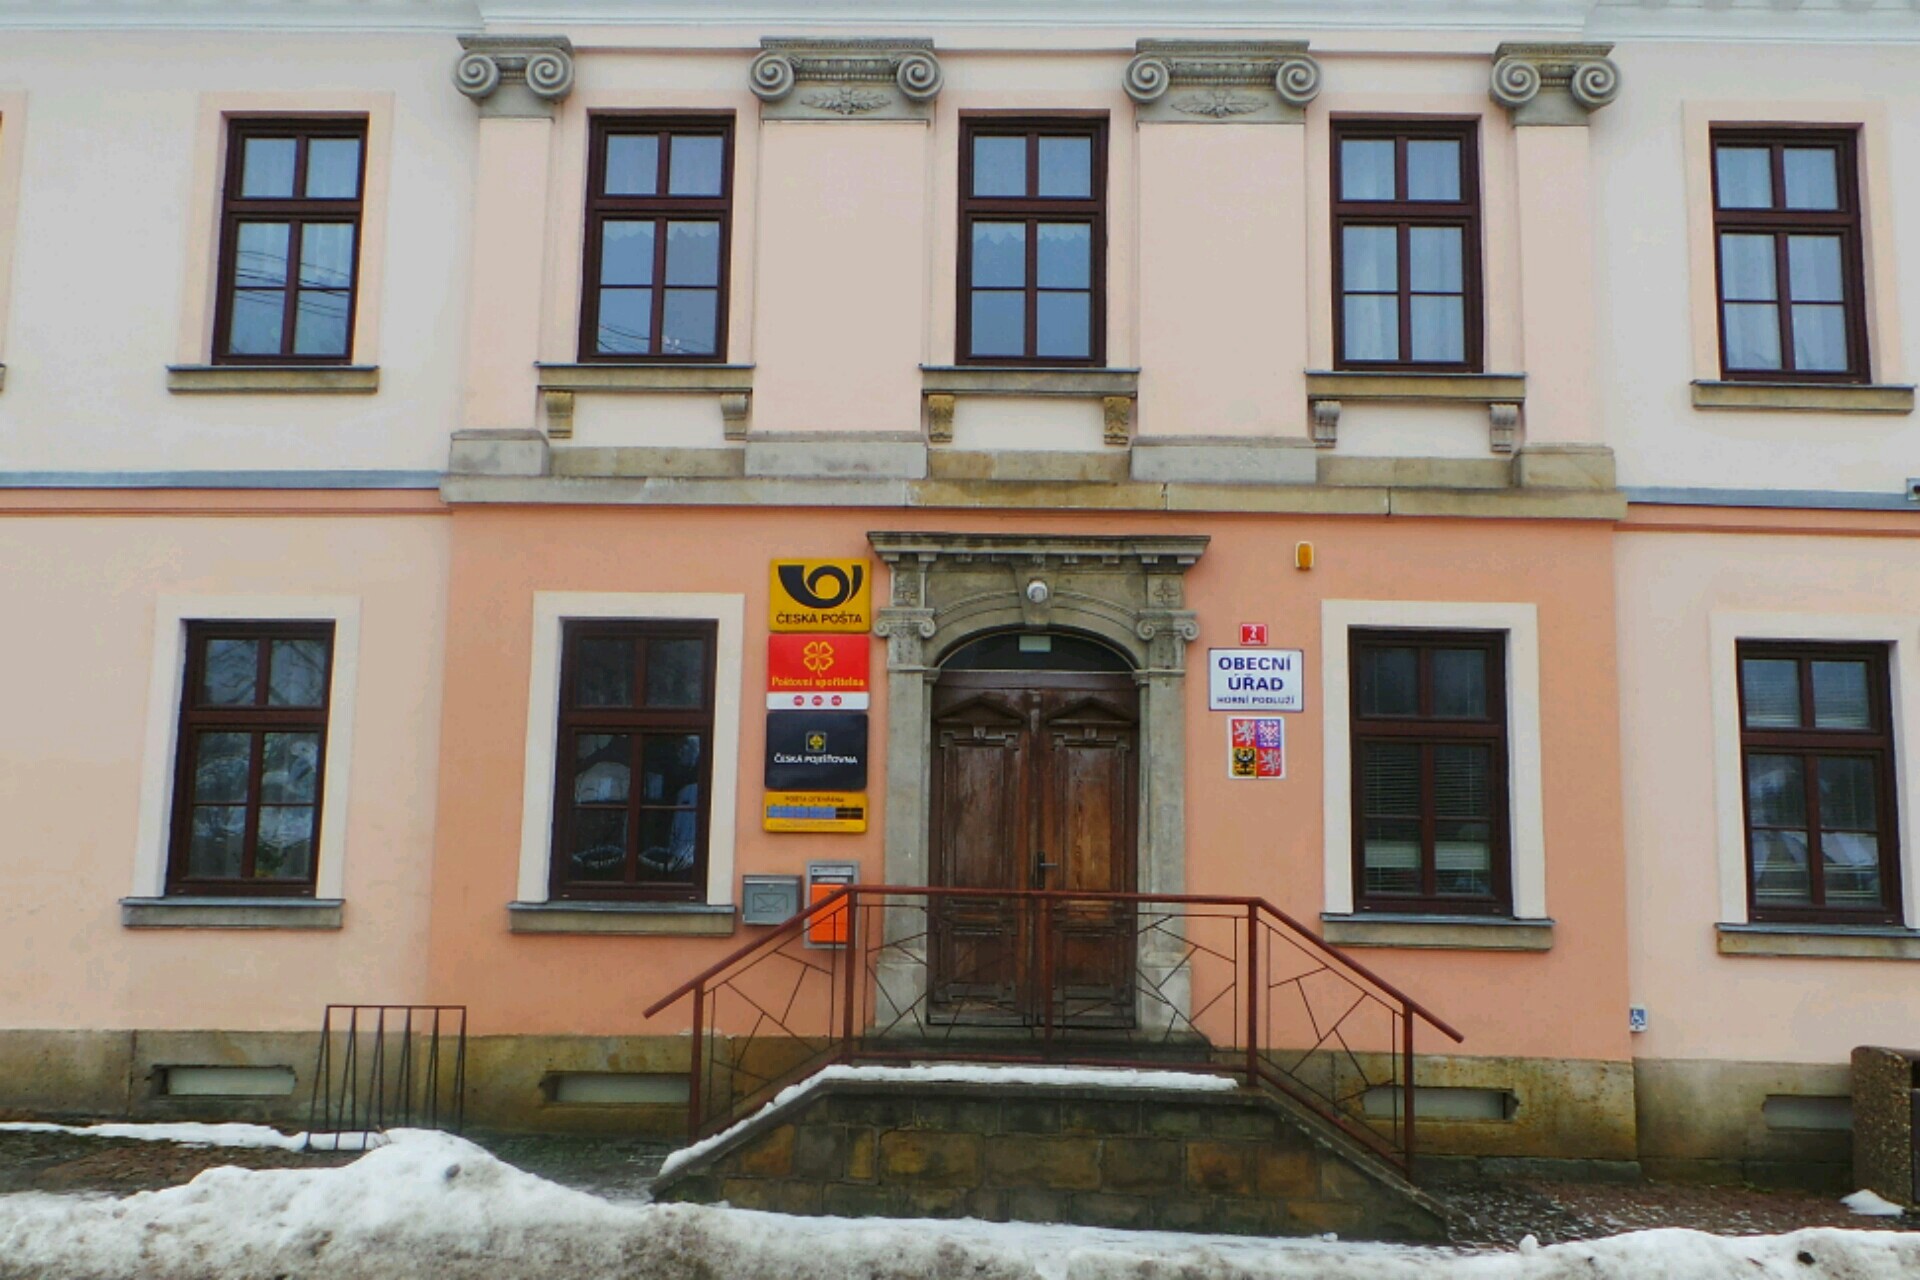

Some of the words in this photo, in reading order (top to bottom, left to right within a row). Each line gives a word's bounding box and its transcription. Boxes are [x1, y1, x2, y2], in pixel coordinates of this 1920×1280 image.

[776, 611, 818, 624] ČESKÁ
[821, 611, 862, 624] POŠTA
[1218, 654, 1292, 671] OBECNÍ
[1228, 673, 1284, 691] ÚŘAD
[1216, 695, 1249, 704] HORNÍ
[1252, 695, 1295, 704] PODLUŽÍ
[774, 752, 803, 763] ČESKÁ
